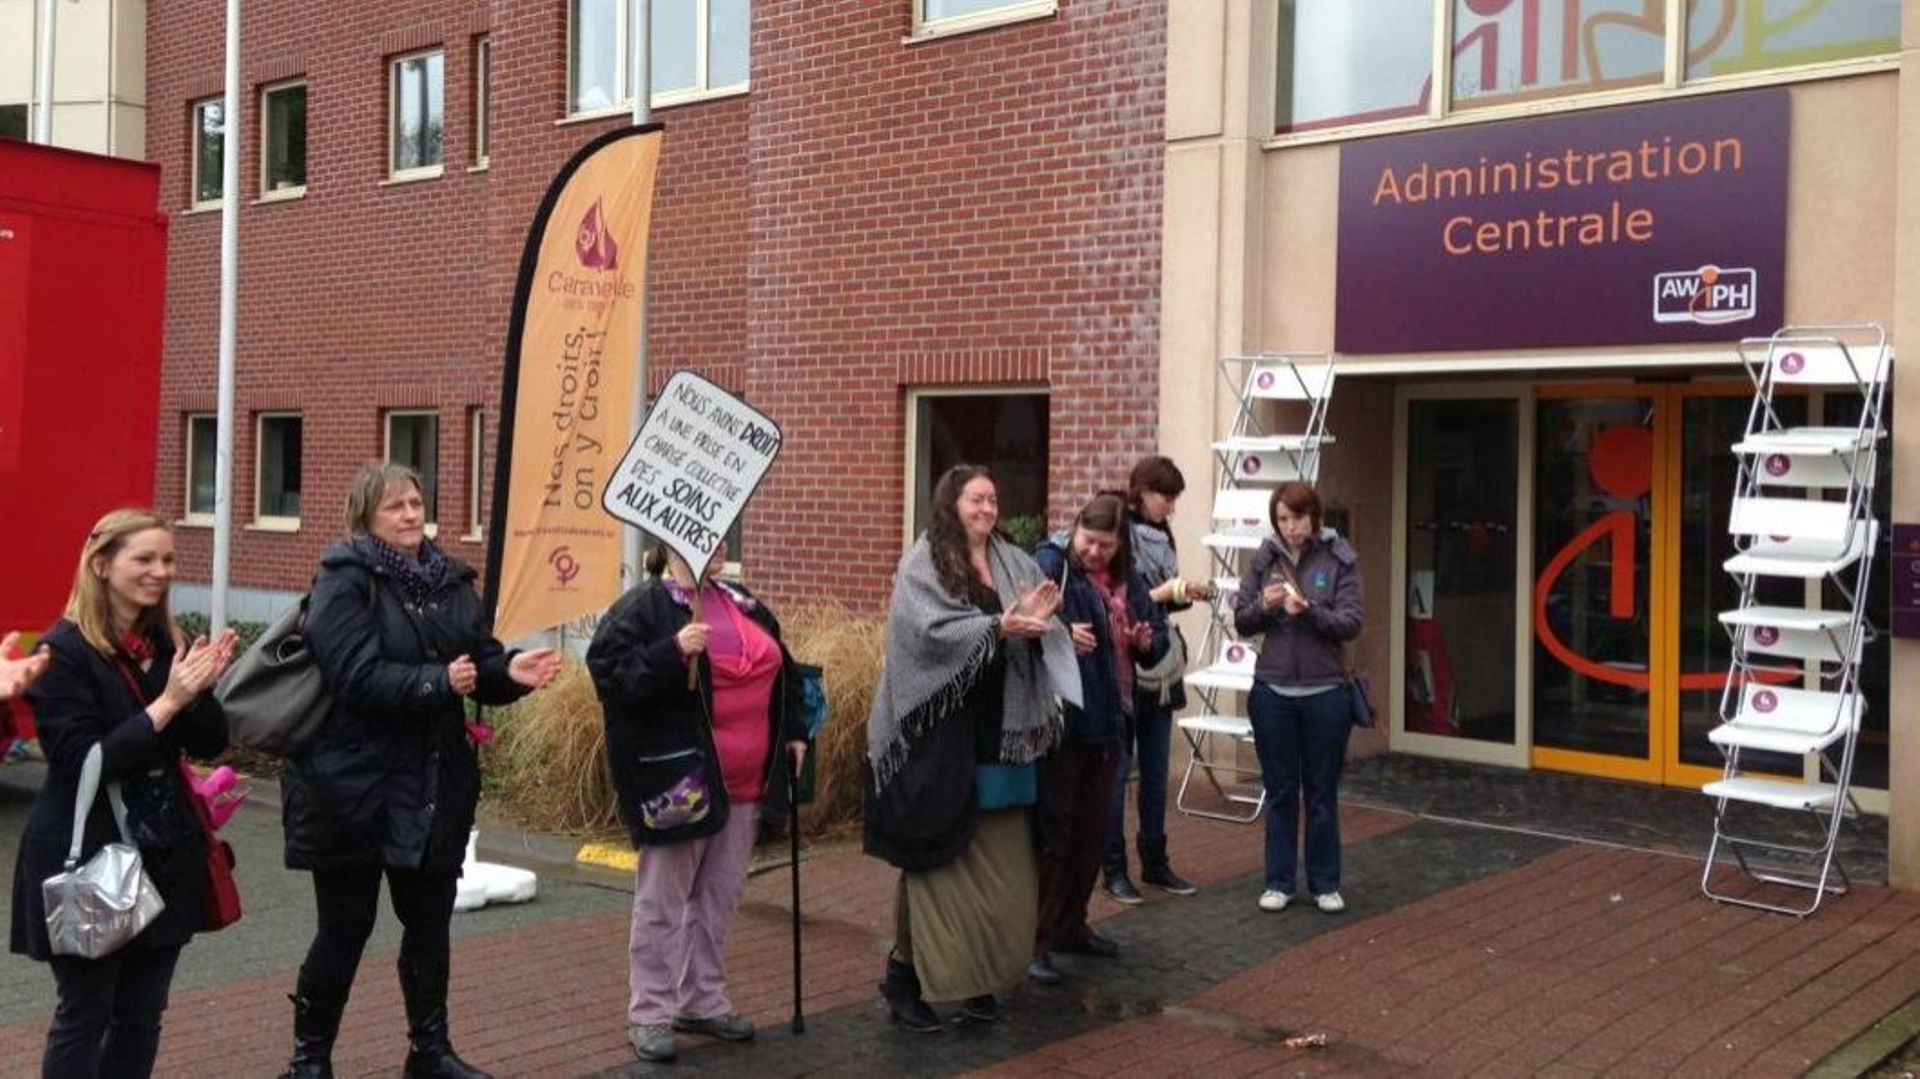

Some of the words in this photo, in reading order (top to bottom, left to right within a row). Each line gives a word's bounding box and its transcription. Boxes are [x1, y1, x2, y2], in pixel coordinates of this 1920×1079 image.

[1374, 136, 1742, 206] Administration
[1443, 202, 1654, 256] Centrale
[577, 434, 602, 455] y
[669, 417, 693, 440] UNE
[694, 431, 724, 459] PRISE
[724, 451, 746, 474] EN
[673, 382, 711, 414] NOUS
[708, 406, 743, 438] AVONS
[739, 421, 779, 457] DROIT
[574, 467, 594, 510] on
[631, 459, 661, 485] DES
[663, 478, 721, 522] SOINS
[645, 434, 688, 467] CHARGE
[685, 460, 742, 502] COLLECTIVE
[617, 482, 660, 518] AUX
[653, 506, 719, 553] AUTRES
